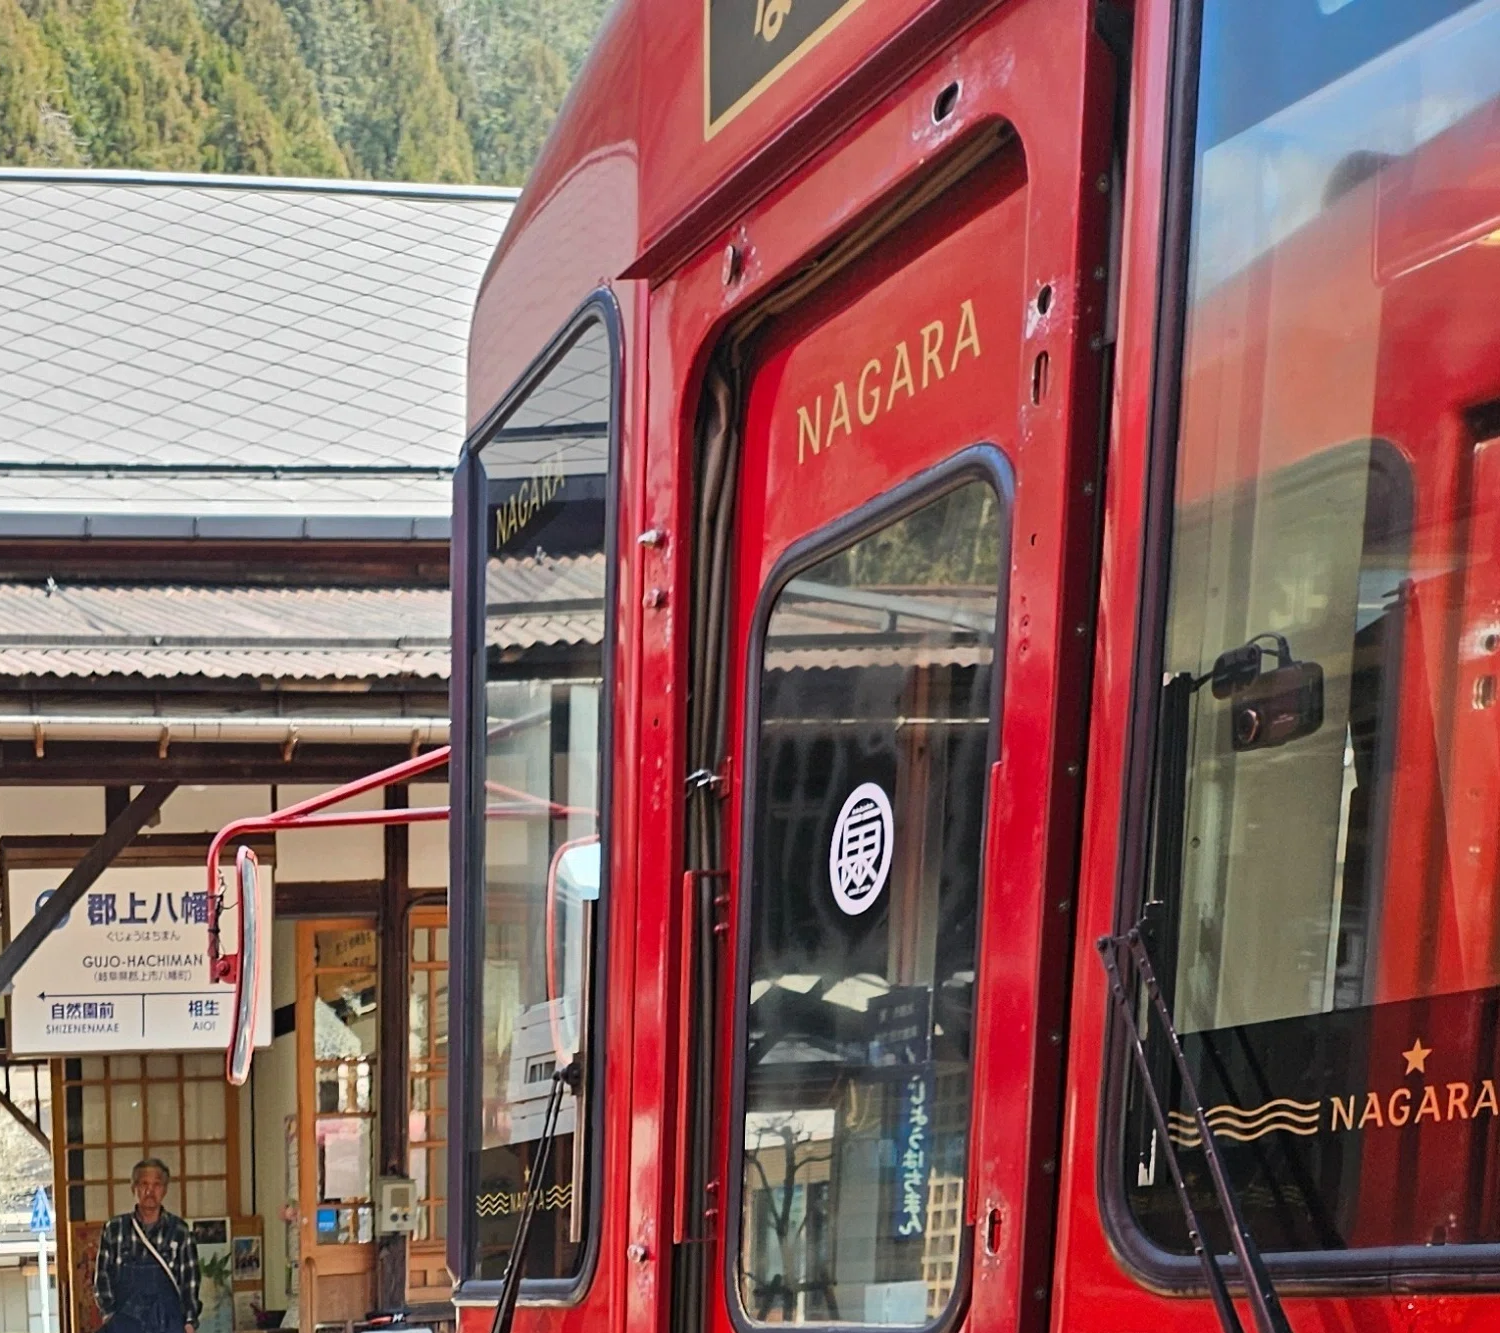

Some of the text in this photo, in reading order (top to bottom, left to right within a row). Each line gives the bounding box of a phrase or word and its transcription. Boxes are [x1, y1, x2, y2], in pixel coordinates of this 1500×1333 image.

[797, 299, 982, 464] NAGARA
[496, 451, 565, 550] NAGARA
[88, 891, 208, 926] 郡上八幡
[82, 954, 203, 969] GUJO-HACHIMAN
[52, 1002, 114, 1020] 自然園前
[189, 1000, 220, 1017] 相生
[46, 1023, 120, 1034] SHIZENENMAE
[192, 1021, 216, 1031] AIOI
[1330, 1080, 1500, 1132] NAGARA
